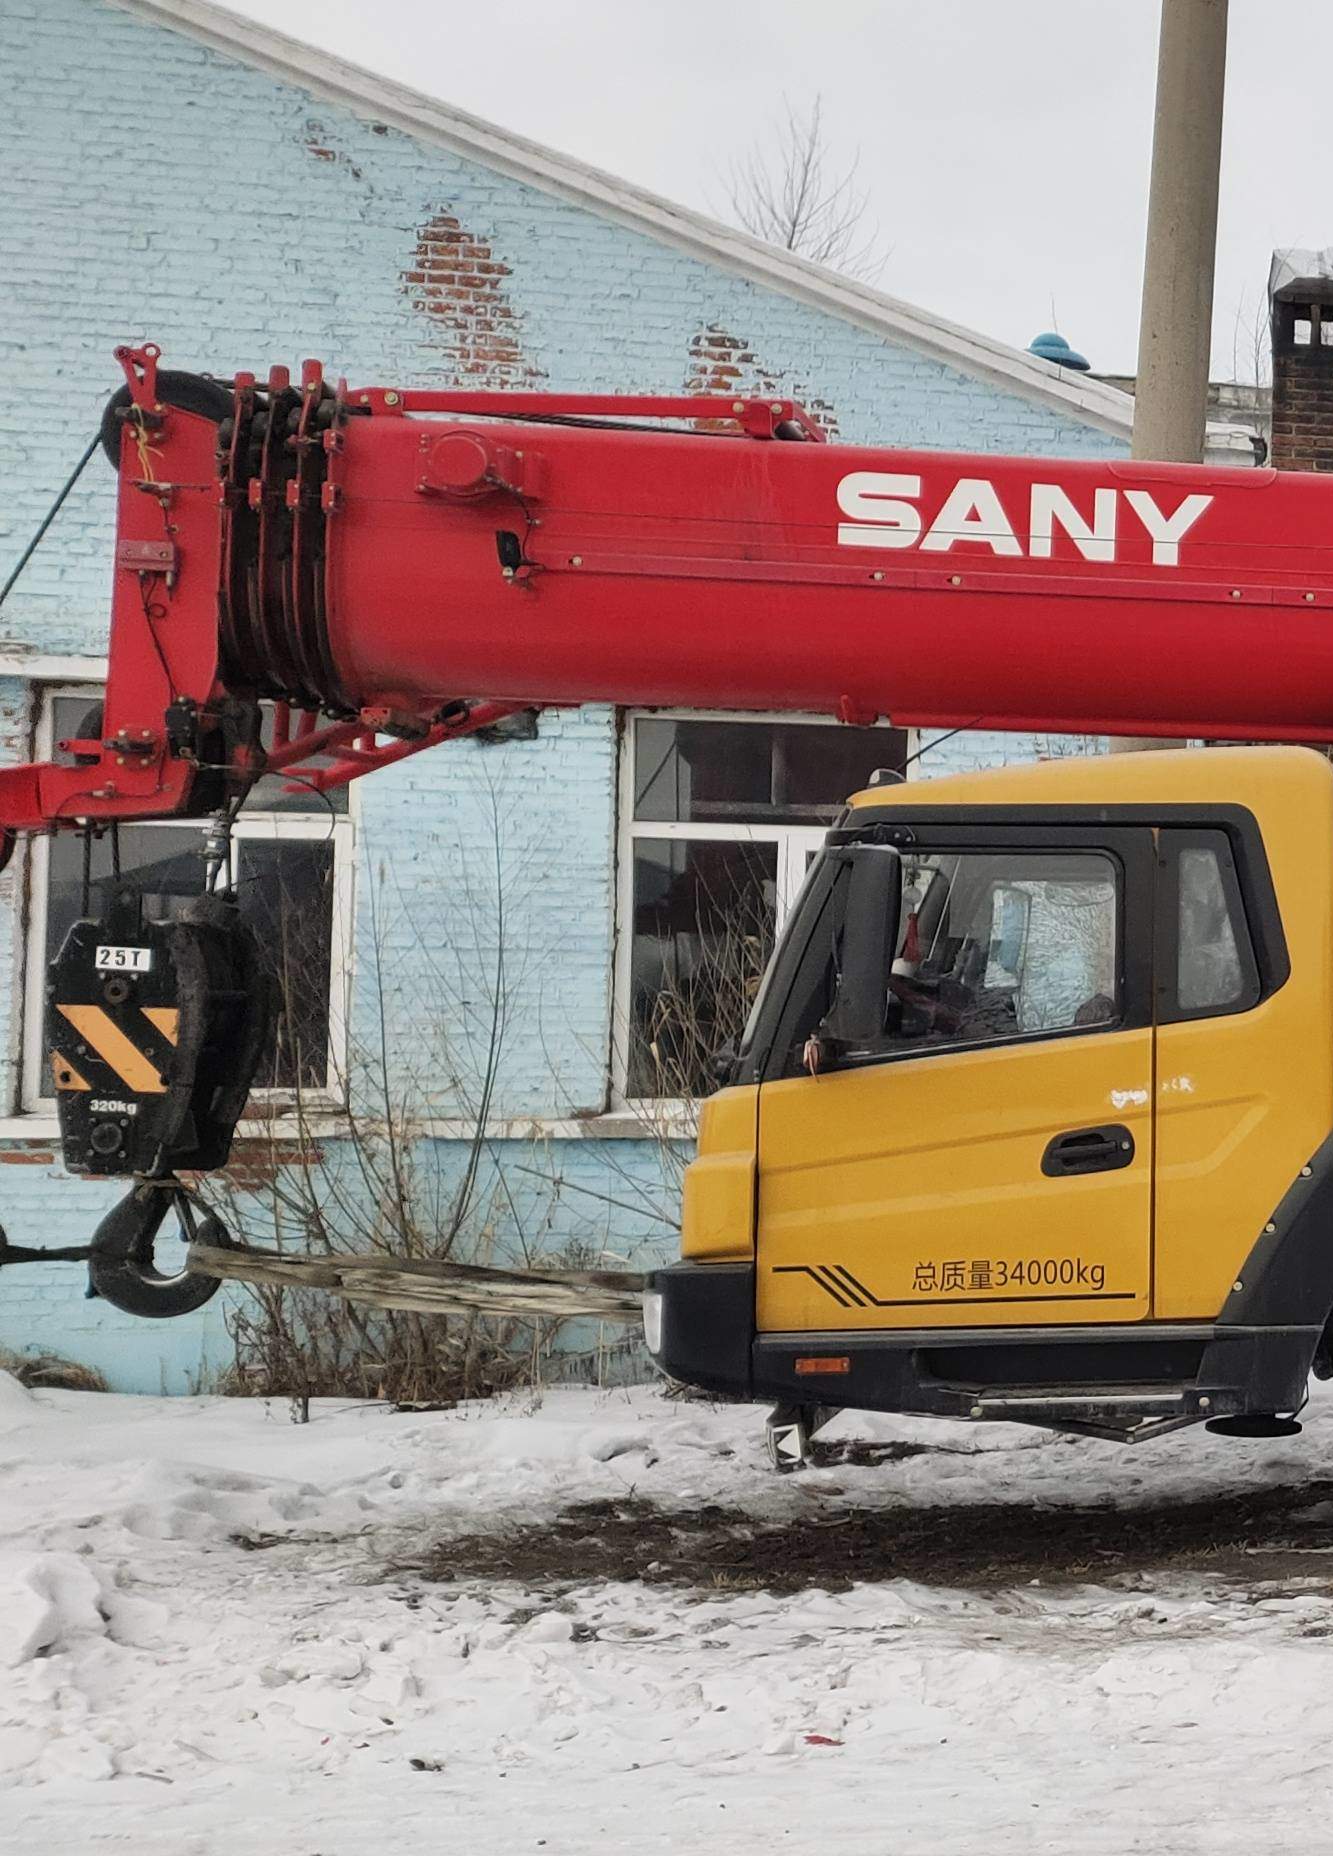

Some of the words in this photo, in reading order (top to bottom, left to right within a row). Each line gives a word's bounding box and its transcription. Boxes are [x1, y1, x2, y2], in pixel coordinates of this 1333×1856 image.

[836, 471, 1214, 567] SANY
[99, 949, 141, 967] 25T
[90, 1100, 137, 1115] 320kg
[912, 1258, 1105, 1291] 总质量34000kg
